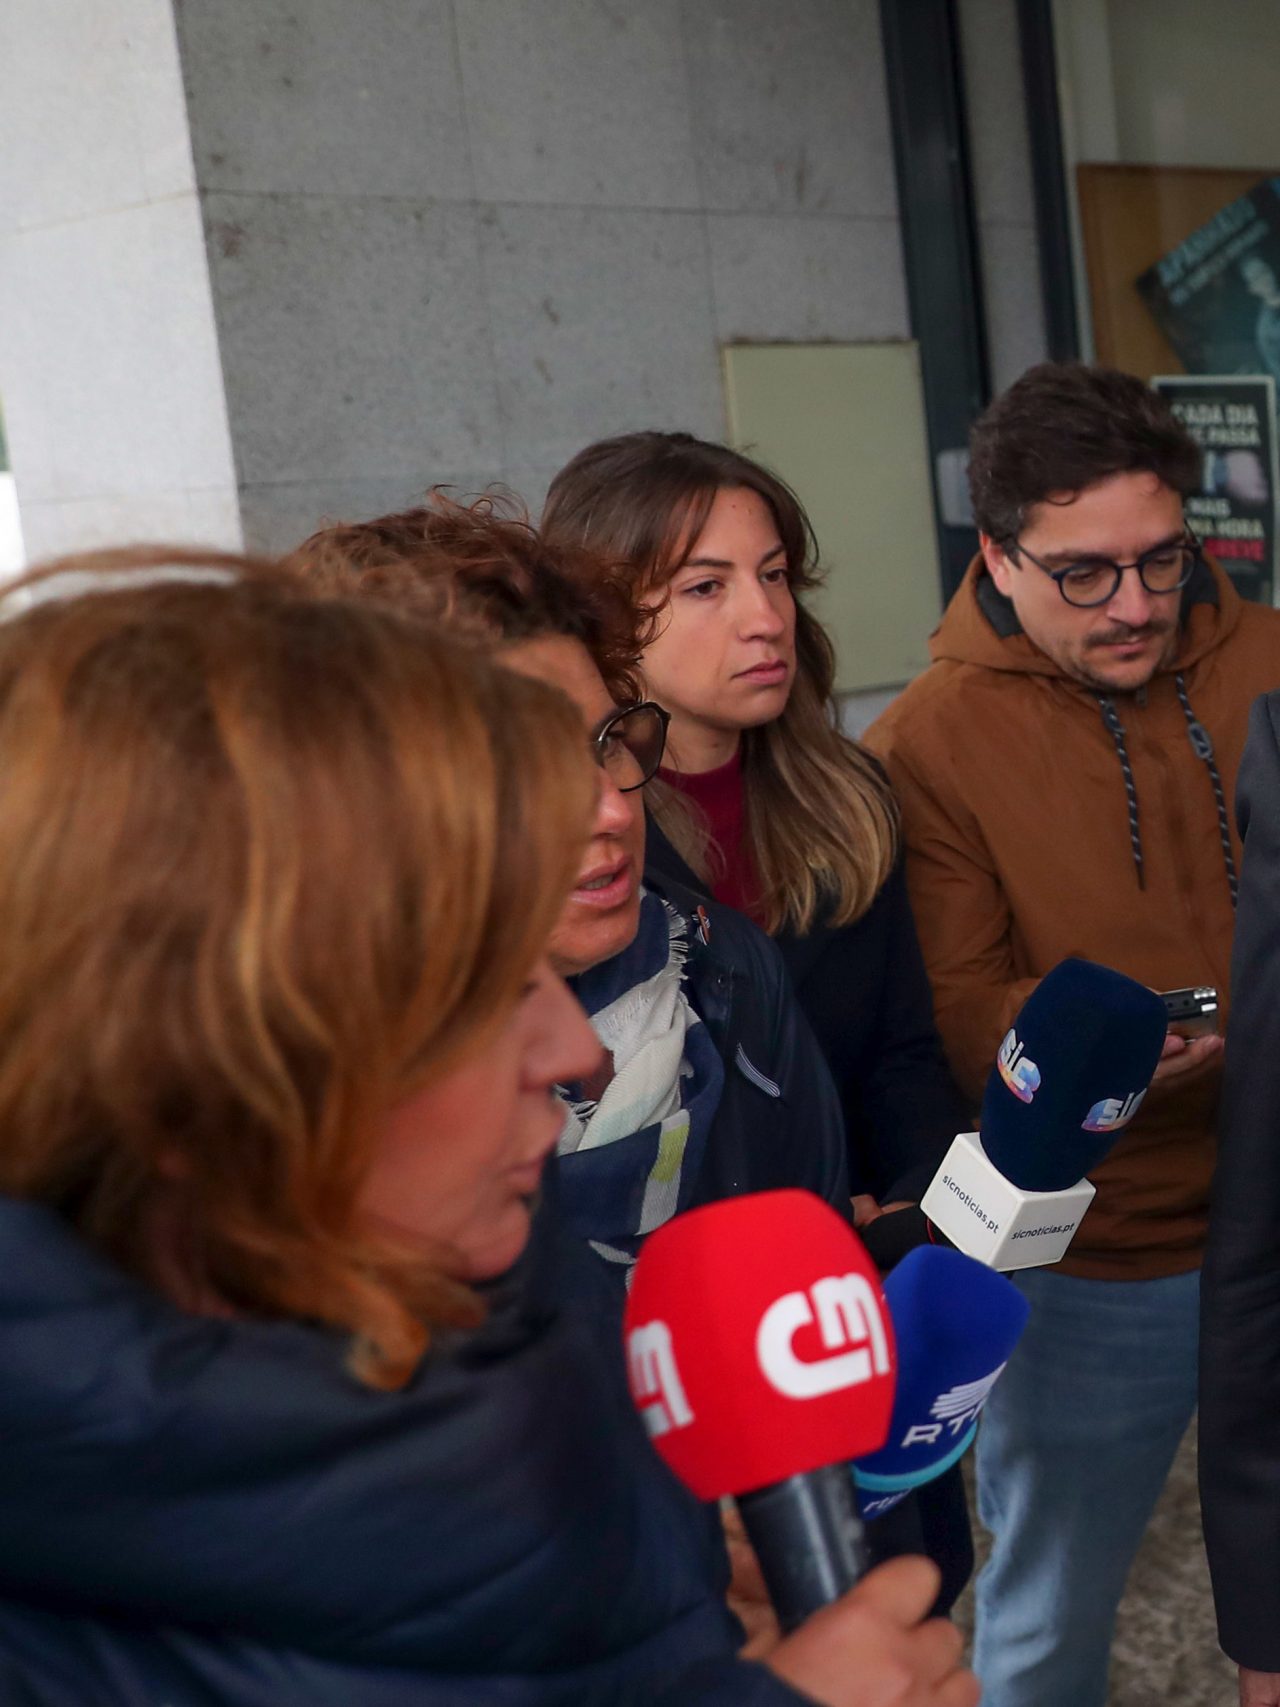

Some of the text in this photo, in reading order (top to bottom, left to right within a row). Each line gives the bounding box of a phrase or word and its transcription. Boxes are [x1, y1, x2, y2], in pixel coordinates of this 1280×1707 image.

[1225, 403, 1260, 425] DIA
[1208, 426, 1262, 447] PASSA
[942, 1174, 999, 1235] sicnoticias.pt
[1011, 1222, 1075, 1240] sicnoticias.pt
